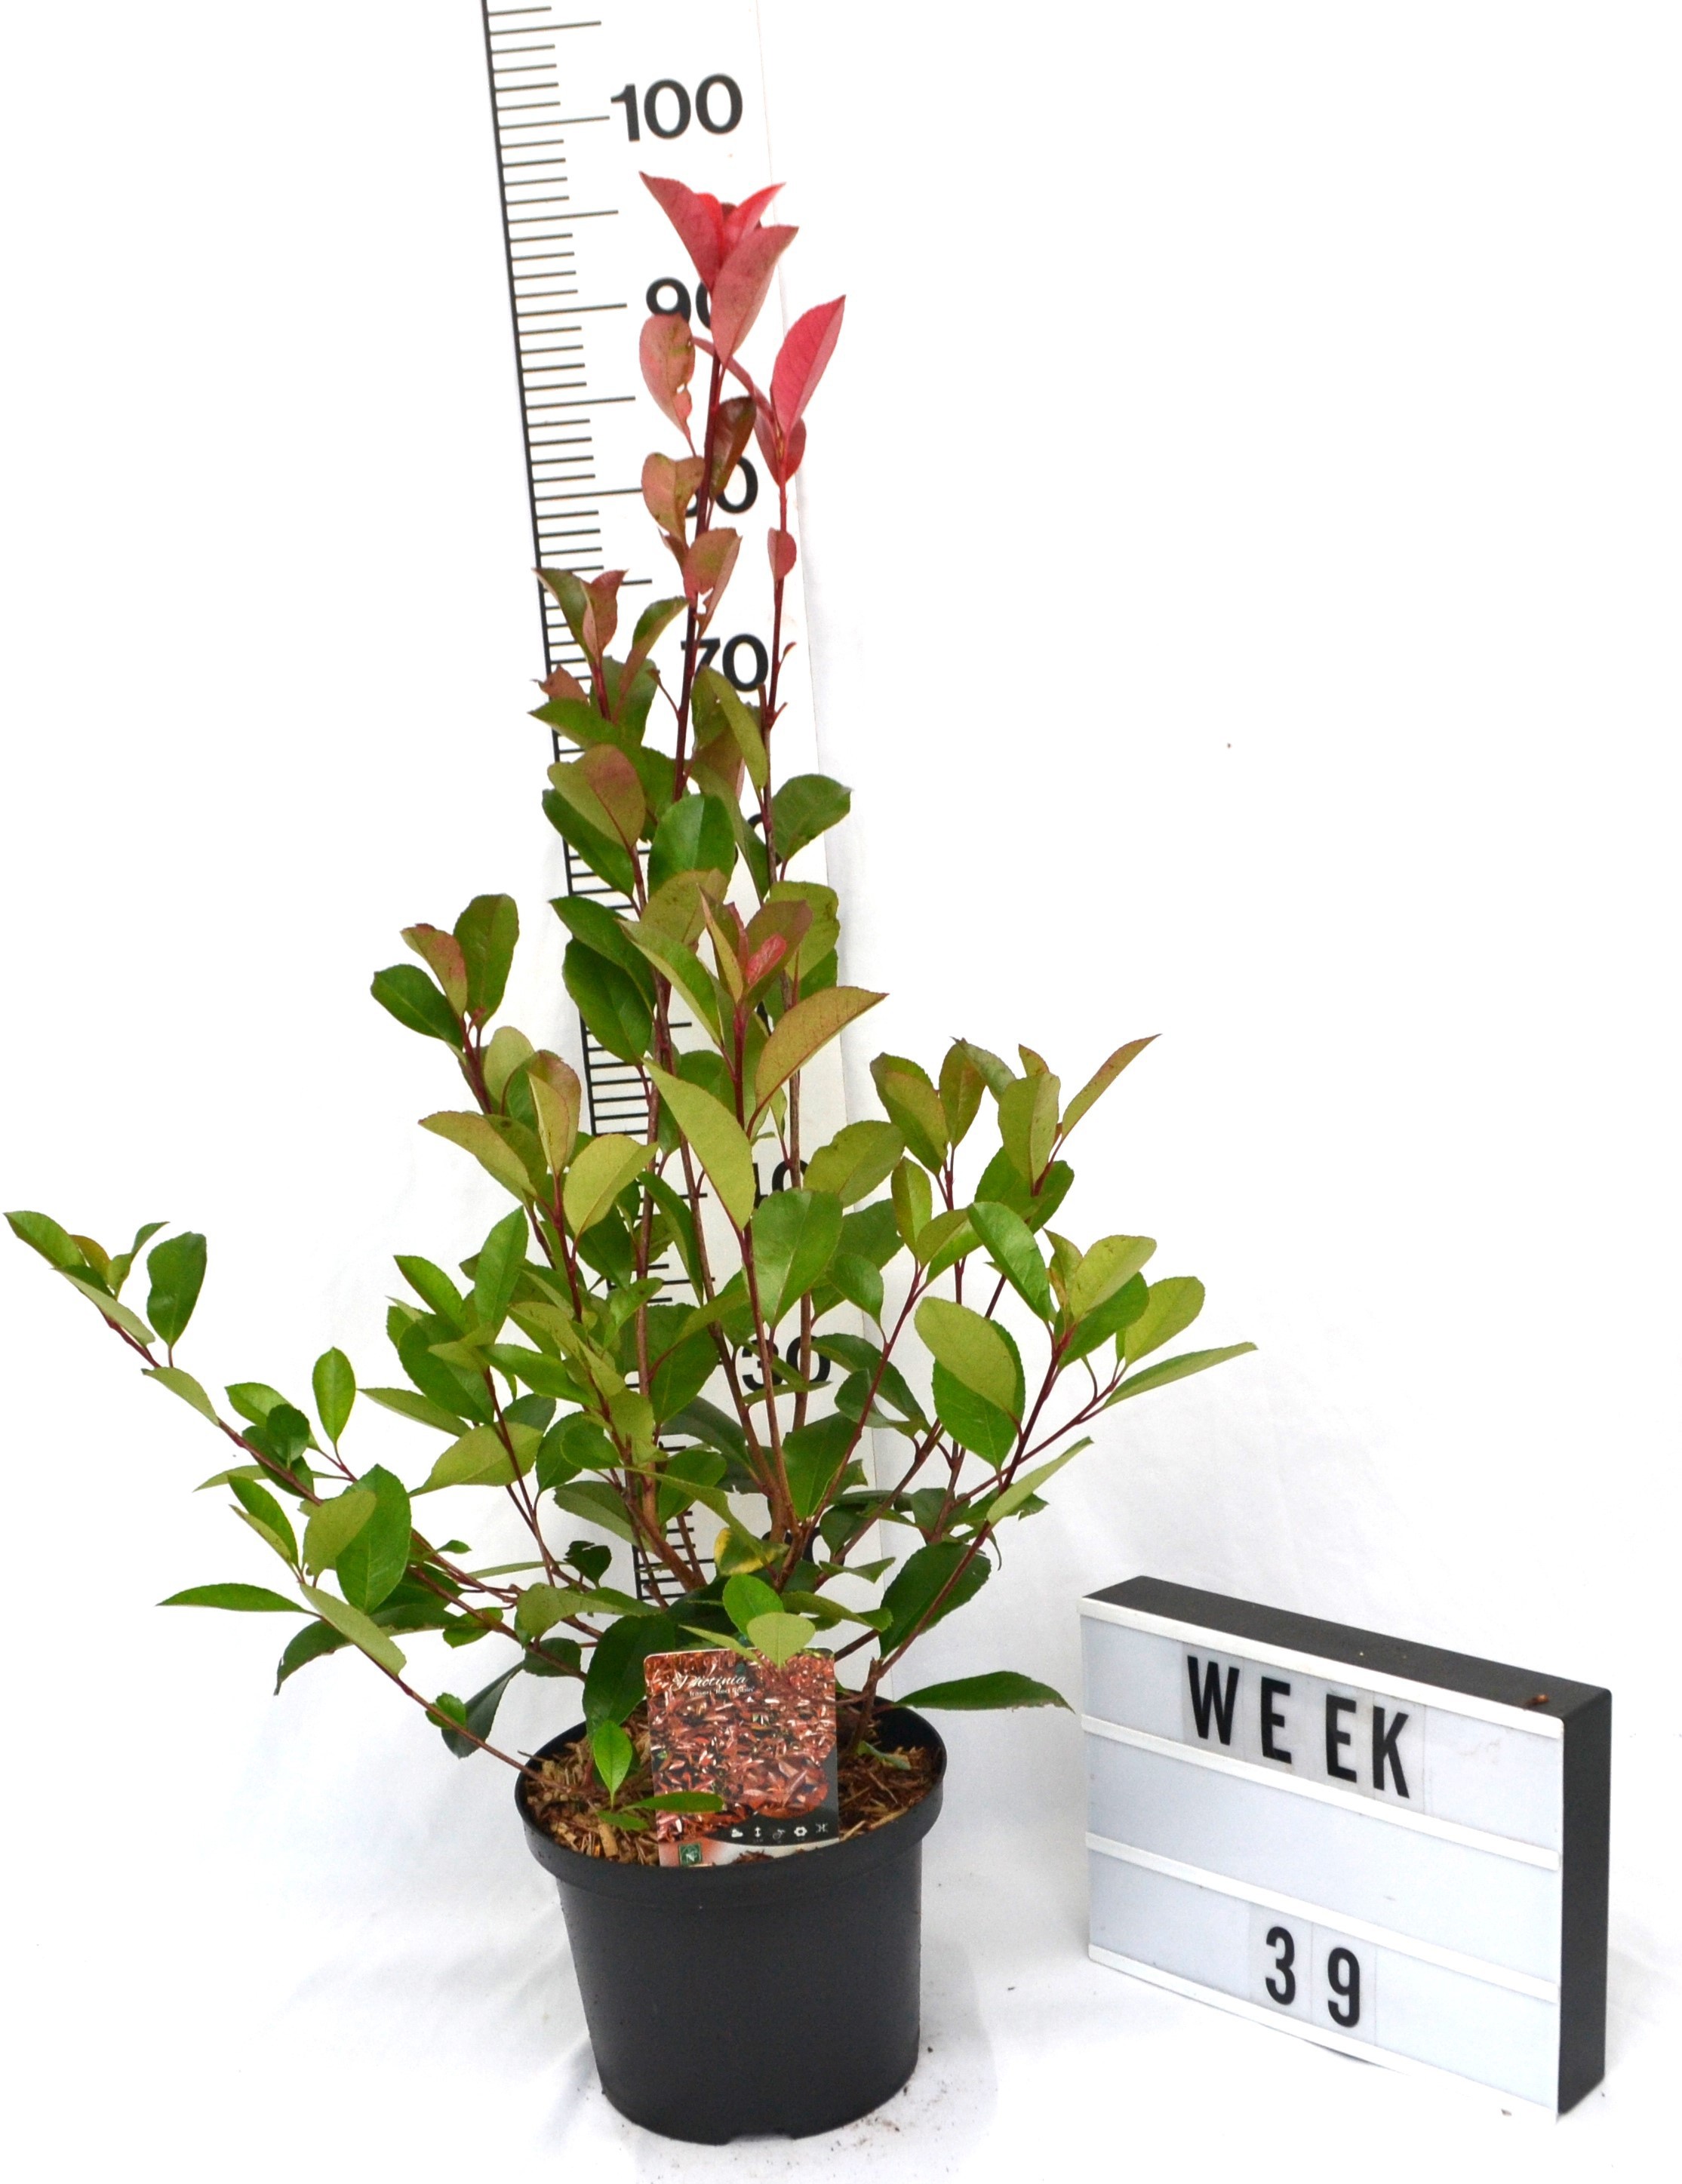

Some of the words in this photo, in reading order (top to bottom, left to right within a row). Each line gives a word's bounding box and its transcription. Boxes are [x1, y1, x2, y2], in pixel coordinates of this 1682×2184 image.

[610, 74, 743, 141] 100
[681, 634, 769, 693] 70
[1186, 1654, 1410, 1799] WEEK
[1265, 1925, 1361, 2028] 39
